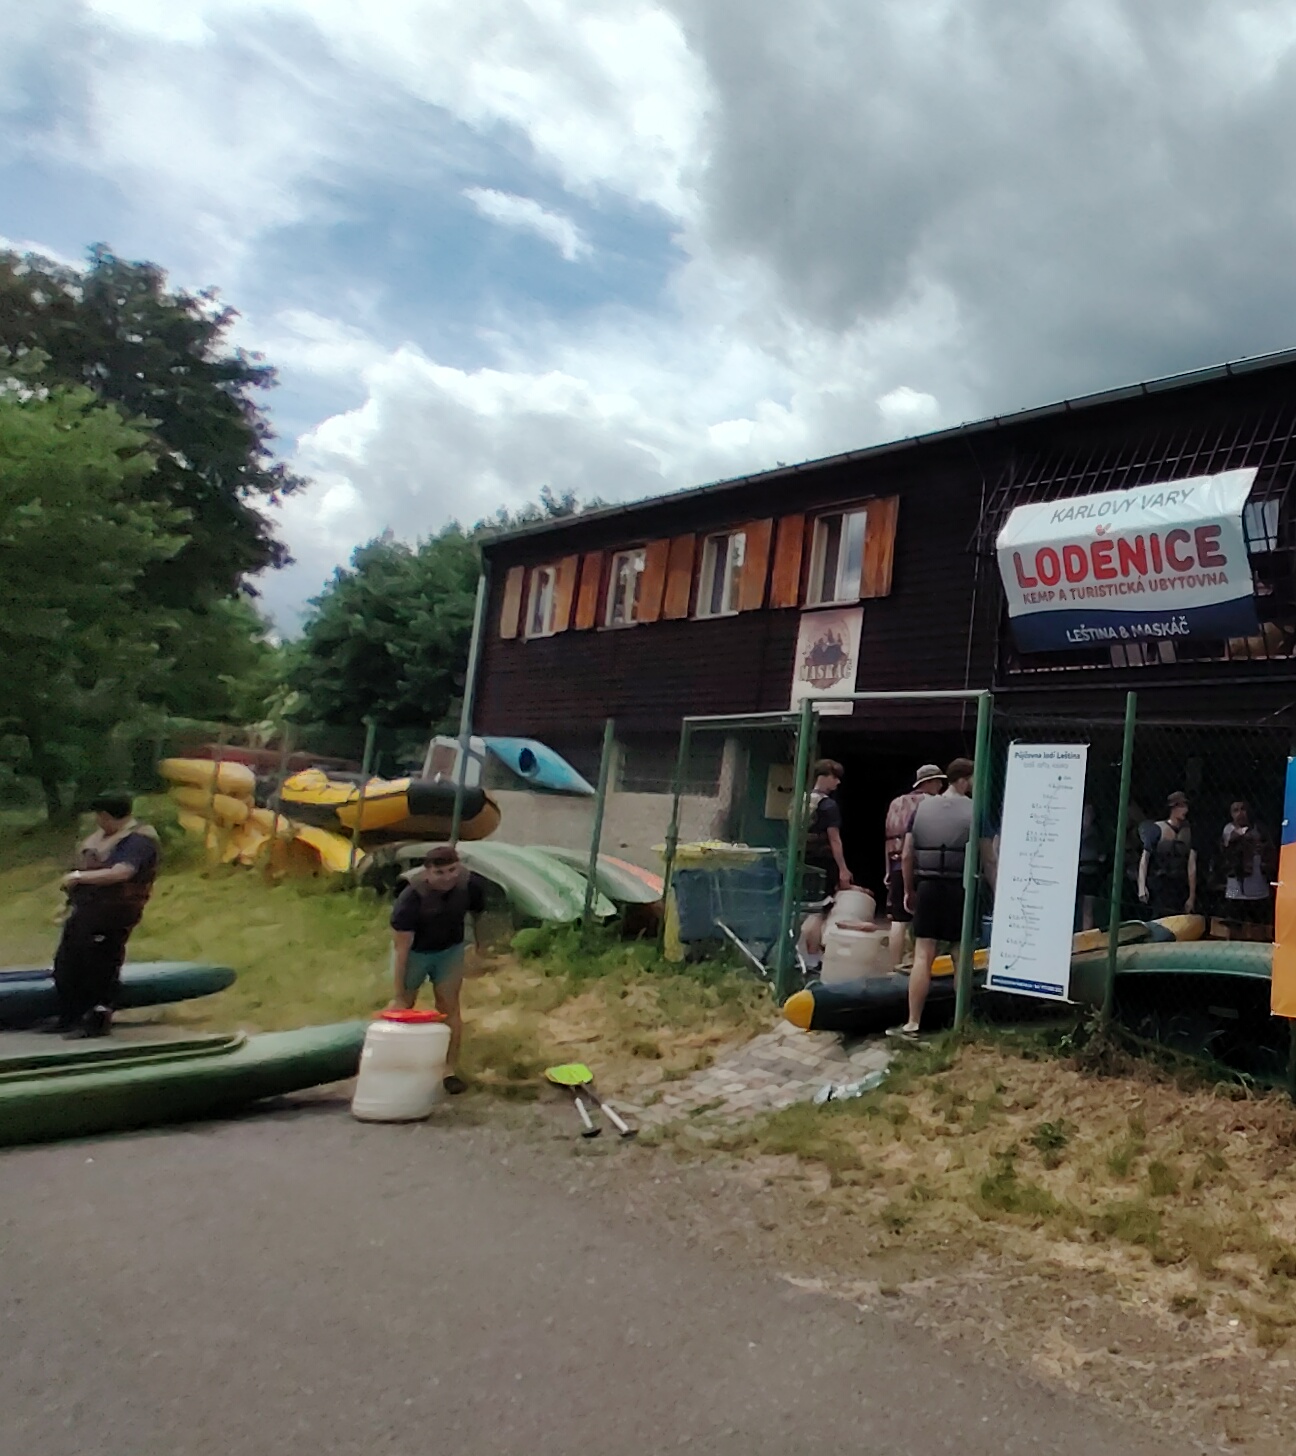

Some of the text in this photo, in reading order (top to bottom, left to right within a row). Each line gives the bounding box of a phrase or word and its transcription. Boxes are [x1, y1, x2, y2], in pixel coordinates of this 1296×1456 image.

[1051, 487, 1195, 524] KARLOVY VARY
[1013, 523, 1228, 589] LODĚNICE
[1023, 571, 1229, 605] KEMP A TURISTICKÁ UBYTOVNA
[1066, 624, 1117, 643] LEŠTINA
[1131, 615, 1190, 639] MASKÁČ
